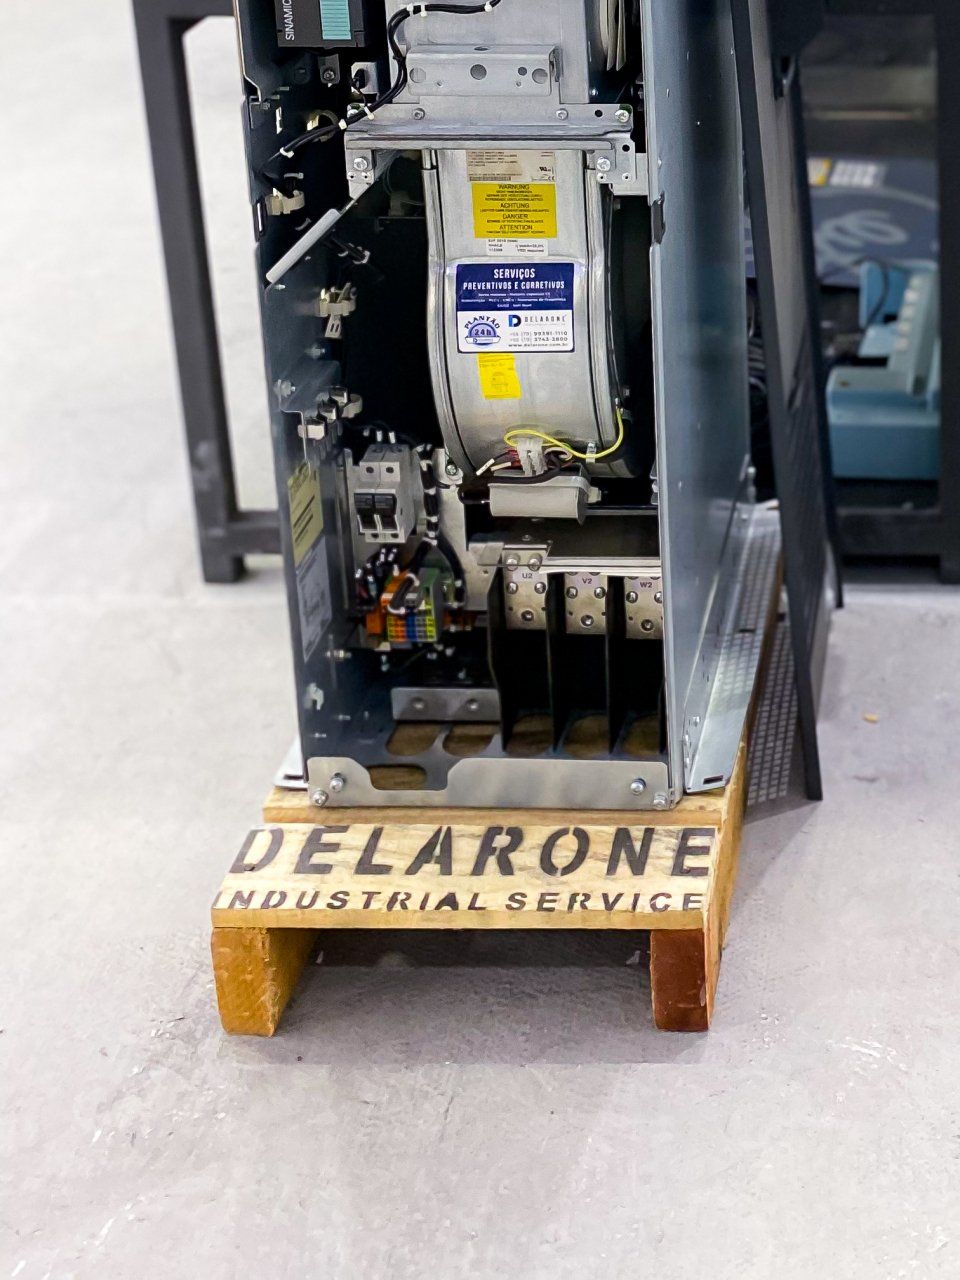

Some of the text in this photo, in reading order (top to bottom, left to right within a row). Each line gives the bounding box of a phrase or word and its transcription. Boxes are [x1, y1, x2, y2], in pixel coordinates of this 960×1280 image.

[493, 268, 536, 280] SERVIÇOS
[463, 280, 565, 290] PREVENTIVOS E CORRETIVOS
[464, 315, 501, 330] PLANTÃO
[474, 328, 492, 336] 24h
[582, 577, 593, 585] V2
[228, 825, 719, 877] DELARONE
[212, 890, 704, 912] INDUSTRIAL SERVICE
